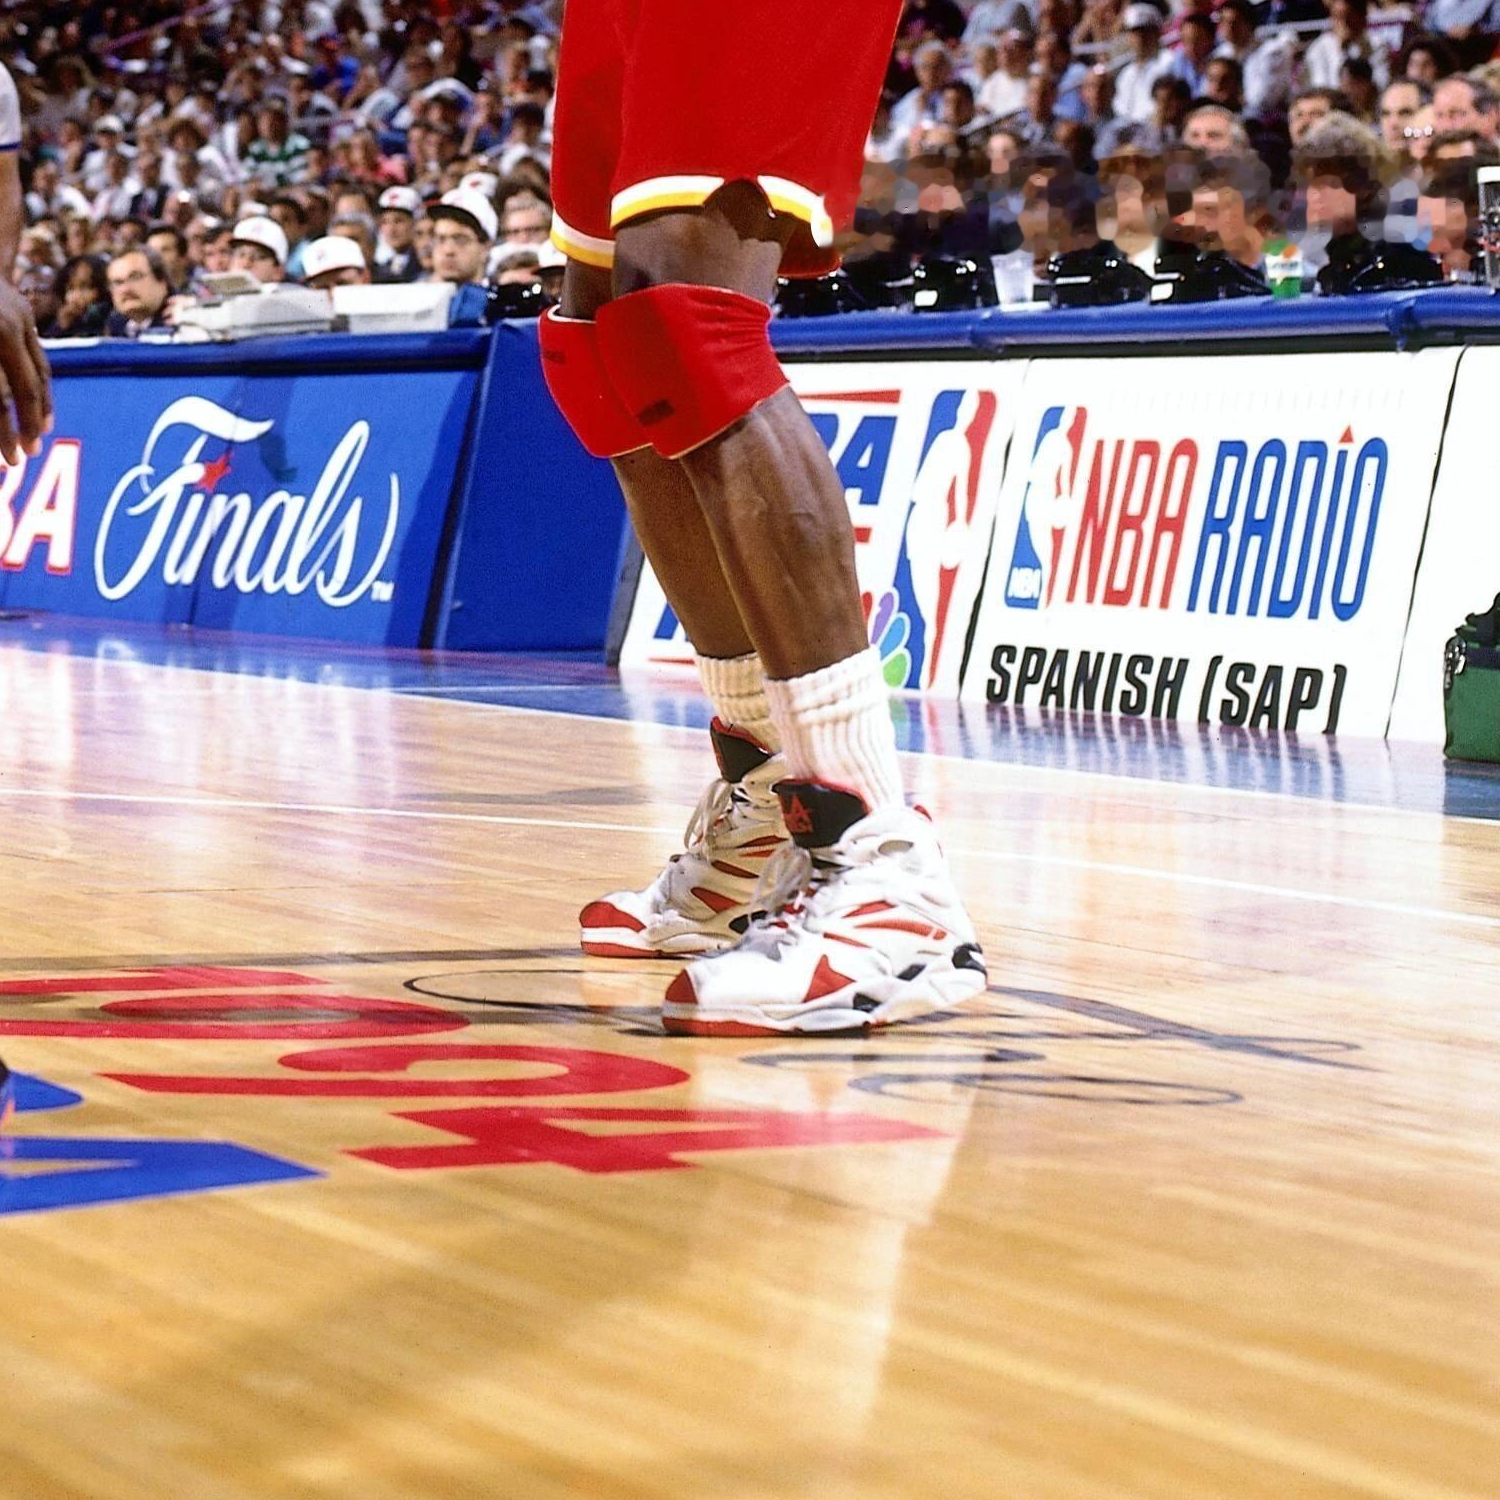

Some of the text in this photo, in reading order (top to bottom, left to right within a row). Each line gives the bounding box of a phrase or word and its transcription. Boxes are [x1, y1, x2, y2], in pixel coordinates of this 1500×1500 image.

[94, 395, 398, 608] Finals
[1065, 438, 1199, 610] NBA
[1186, 426, 1389, 622] RADIO
[985, 643, 1190, 720] SPANISH
